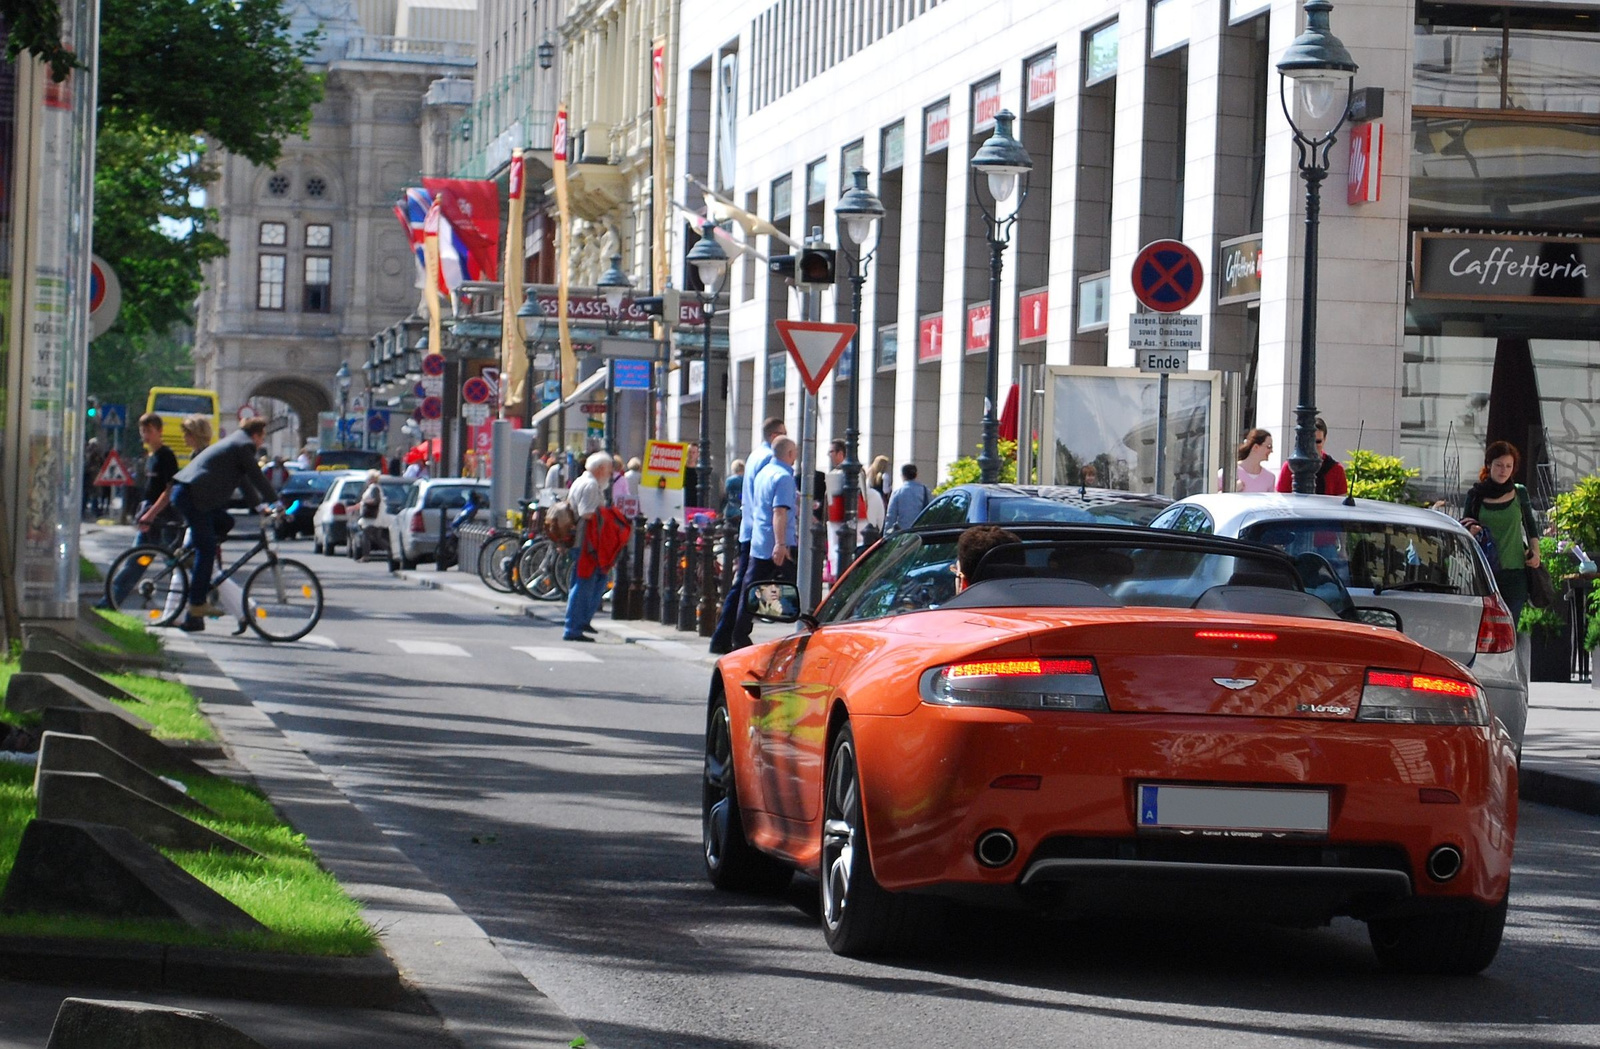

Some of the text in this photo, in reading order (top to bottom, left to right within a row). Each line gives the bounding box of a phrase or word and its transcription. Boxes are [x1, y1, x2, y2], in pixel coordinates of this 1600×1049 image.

[1139, 328, 1193, 336] sowie Omnibusse
[1148, 355, 1180, 369] Ende
[1311, 704, 1351, 715] Vantage
[1145, 810, 1154, 820] A
